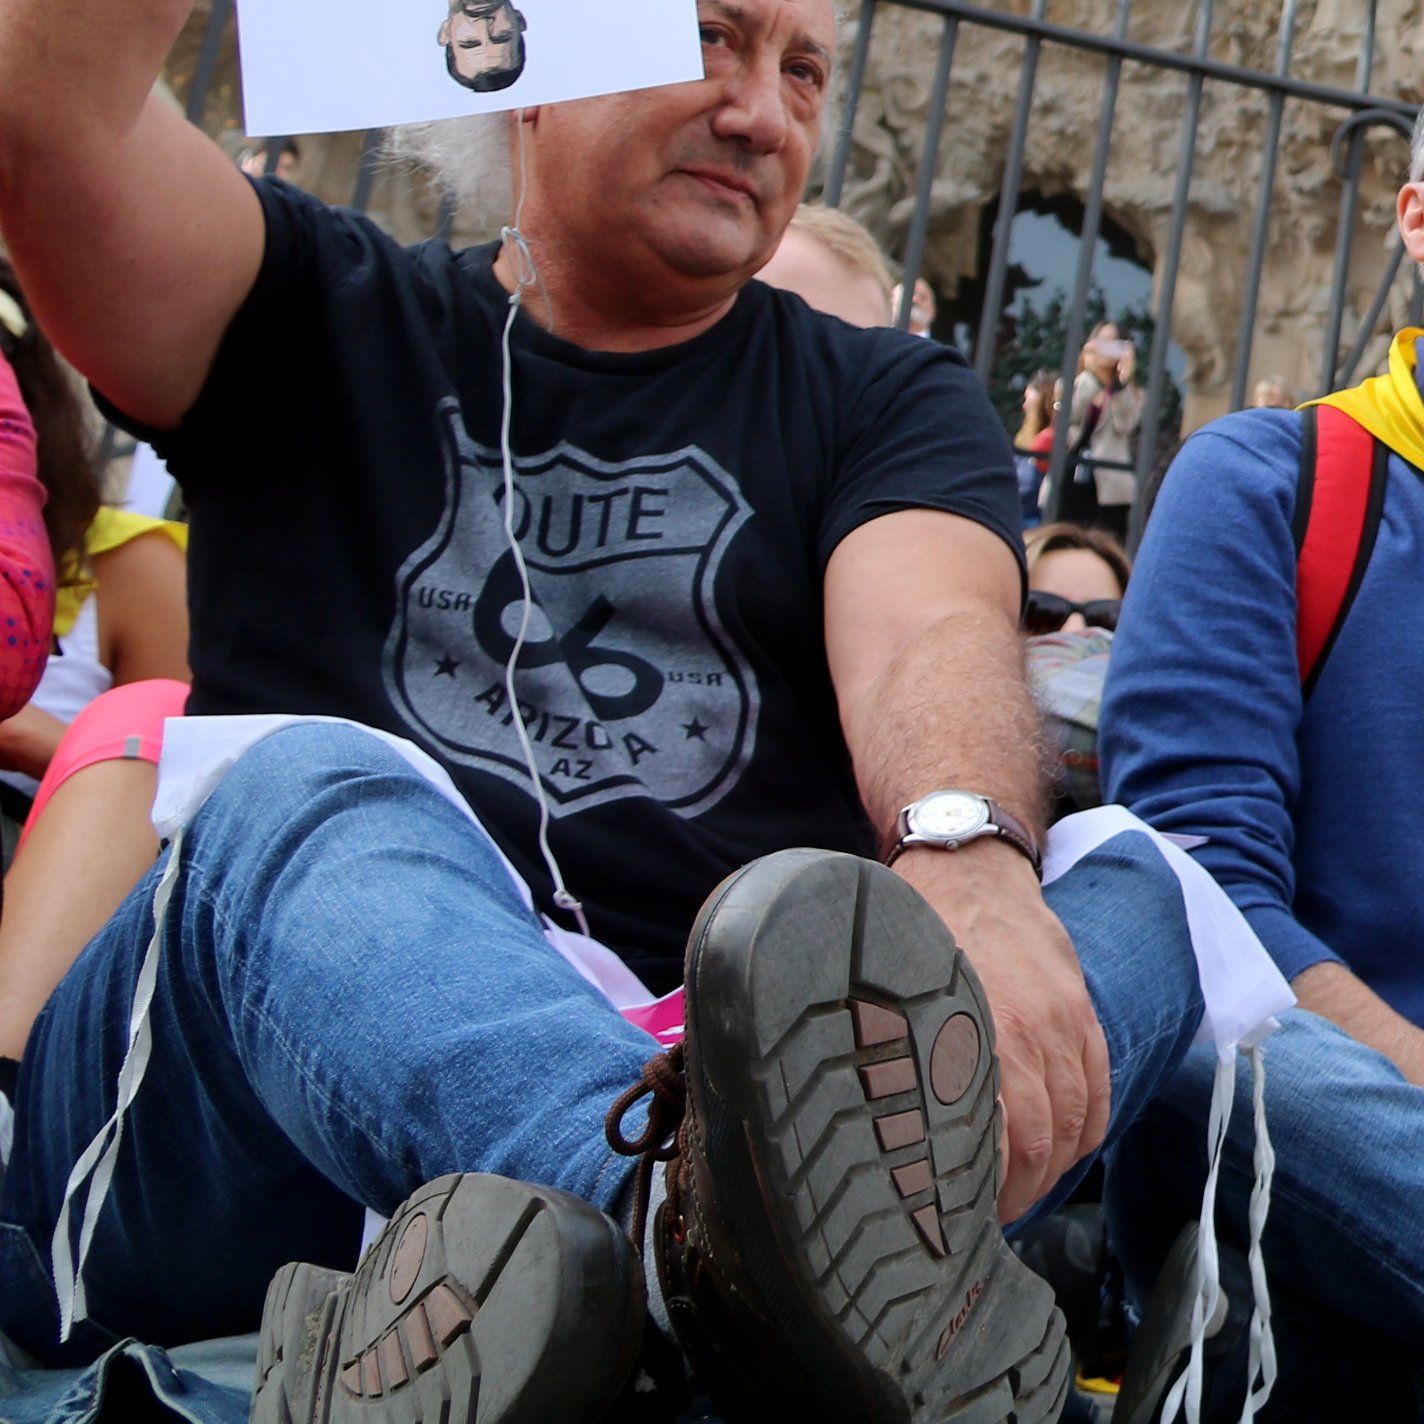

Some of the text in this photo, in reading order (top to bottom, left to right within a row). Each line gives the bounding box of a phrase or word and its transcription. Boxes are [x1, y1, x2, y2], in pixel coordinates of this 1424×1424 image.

[492, 482, 670, 558] OUTE
[418, 586, 474, 613] USA
[549, 757, 595, 781] AZ
